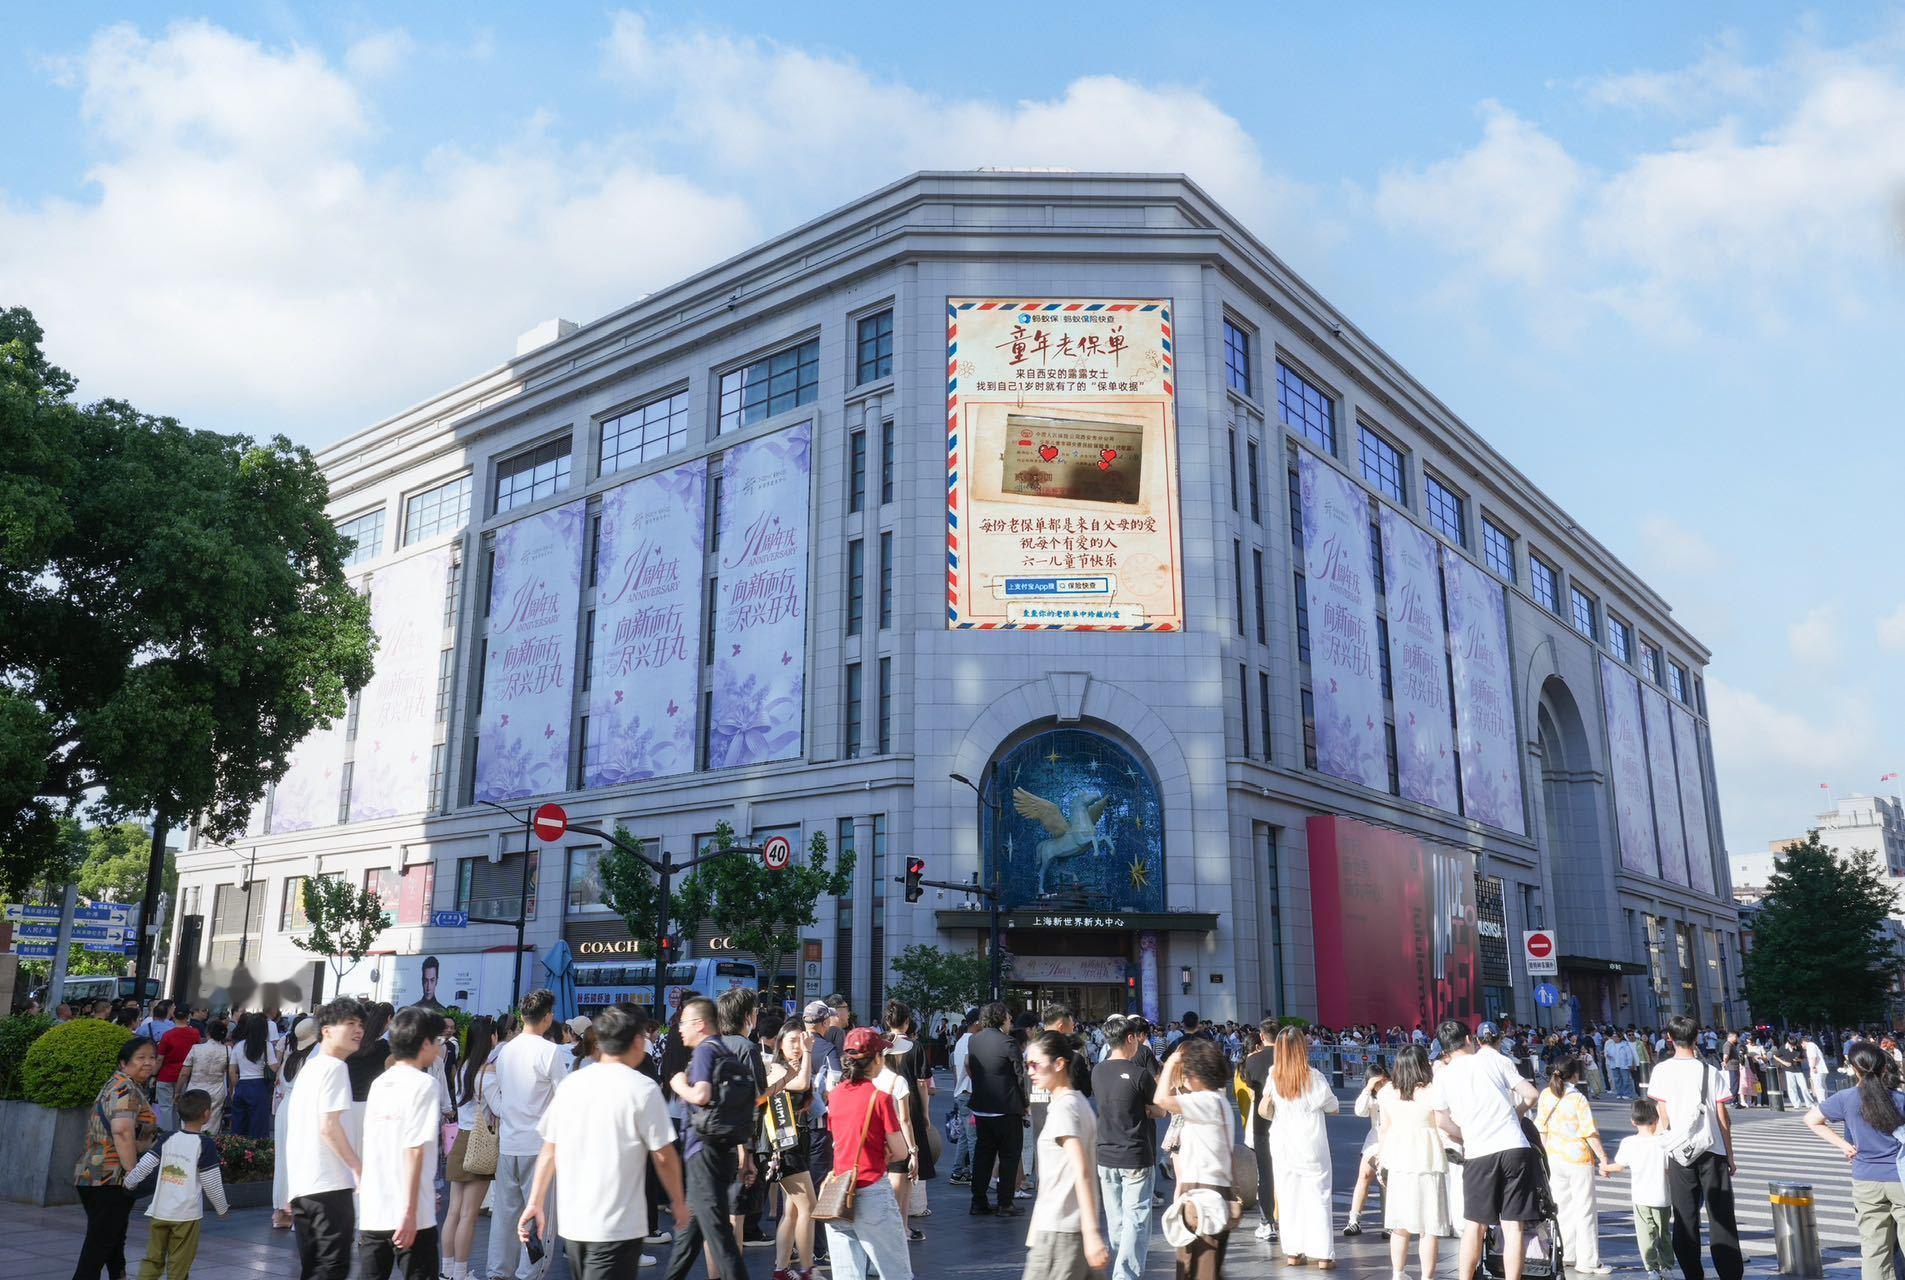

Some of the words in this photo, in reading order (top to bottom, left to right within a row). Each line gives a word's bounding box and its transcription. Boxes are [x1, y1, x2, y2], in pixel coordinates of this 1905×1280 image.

[1032, 315, 1059, 323] 蚂蚁保
[1063, 315, 1115, 323] 蚂蚁保险快查
[995, 325, 1129, 367] 童年老保单
[1015, 368, 1109, 379] 来自西安的露露女士
[979, 516, 1157, 533] 每份老保单都是来自父母的爱
[1020, 535, 1118, 550] 祝每个有爱的人
[1022, 553, 1118, 569] 六一儿童节快乐
[730, 568, 796, 607] 向新而行
[614, 602, 685, 646] 向新而行
[769, 845, 785, 862] 40
[1032, 916, 1125, 927] 上海新世界新丸中心
[580, 941, 639, 954] COACH
[773, 1097, 787, 1126] KUMA
